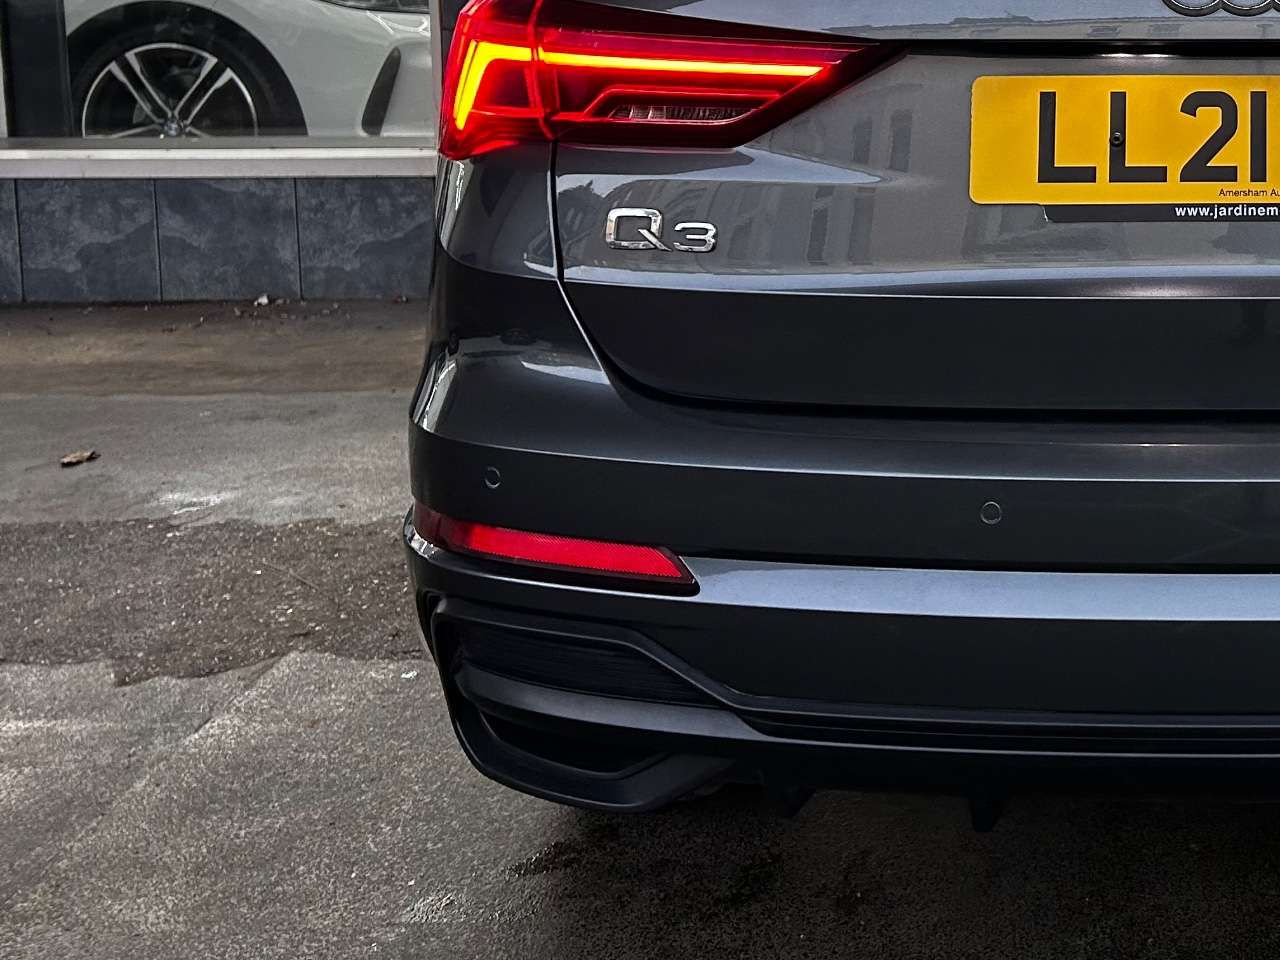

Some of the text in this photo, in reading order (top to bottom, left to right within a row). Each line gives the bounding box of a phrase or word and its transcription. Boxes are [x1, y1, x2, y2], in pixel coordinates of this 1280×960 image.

[1037, 90, 1268, 184] LL21
[1218, 188, 1268, 197] Amersham
[605, 207, 717, 252] Q3
